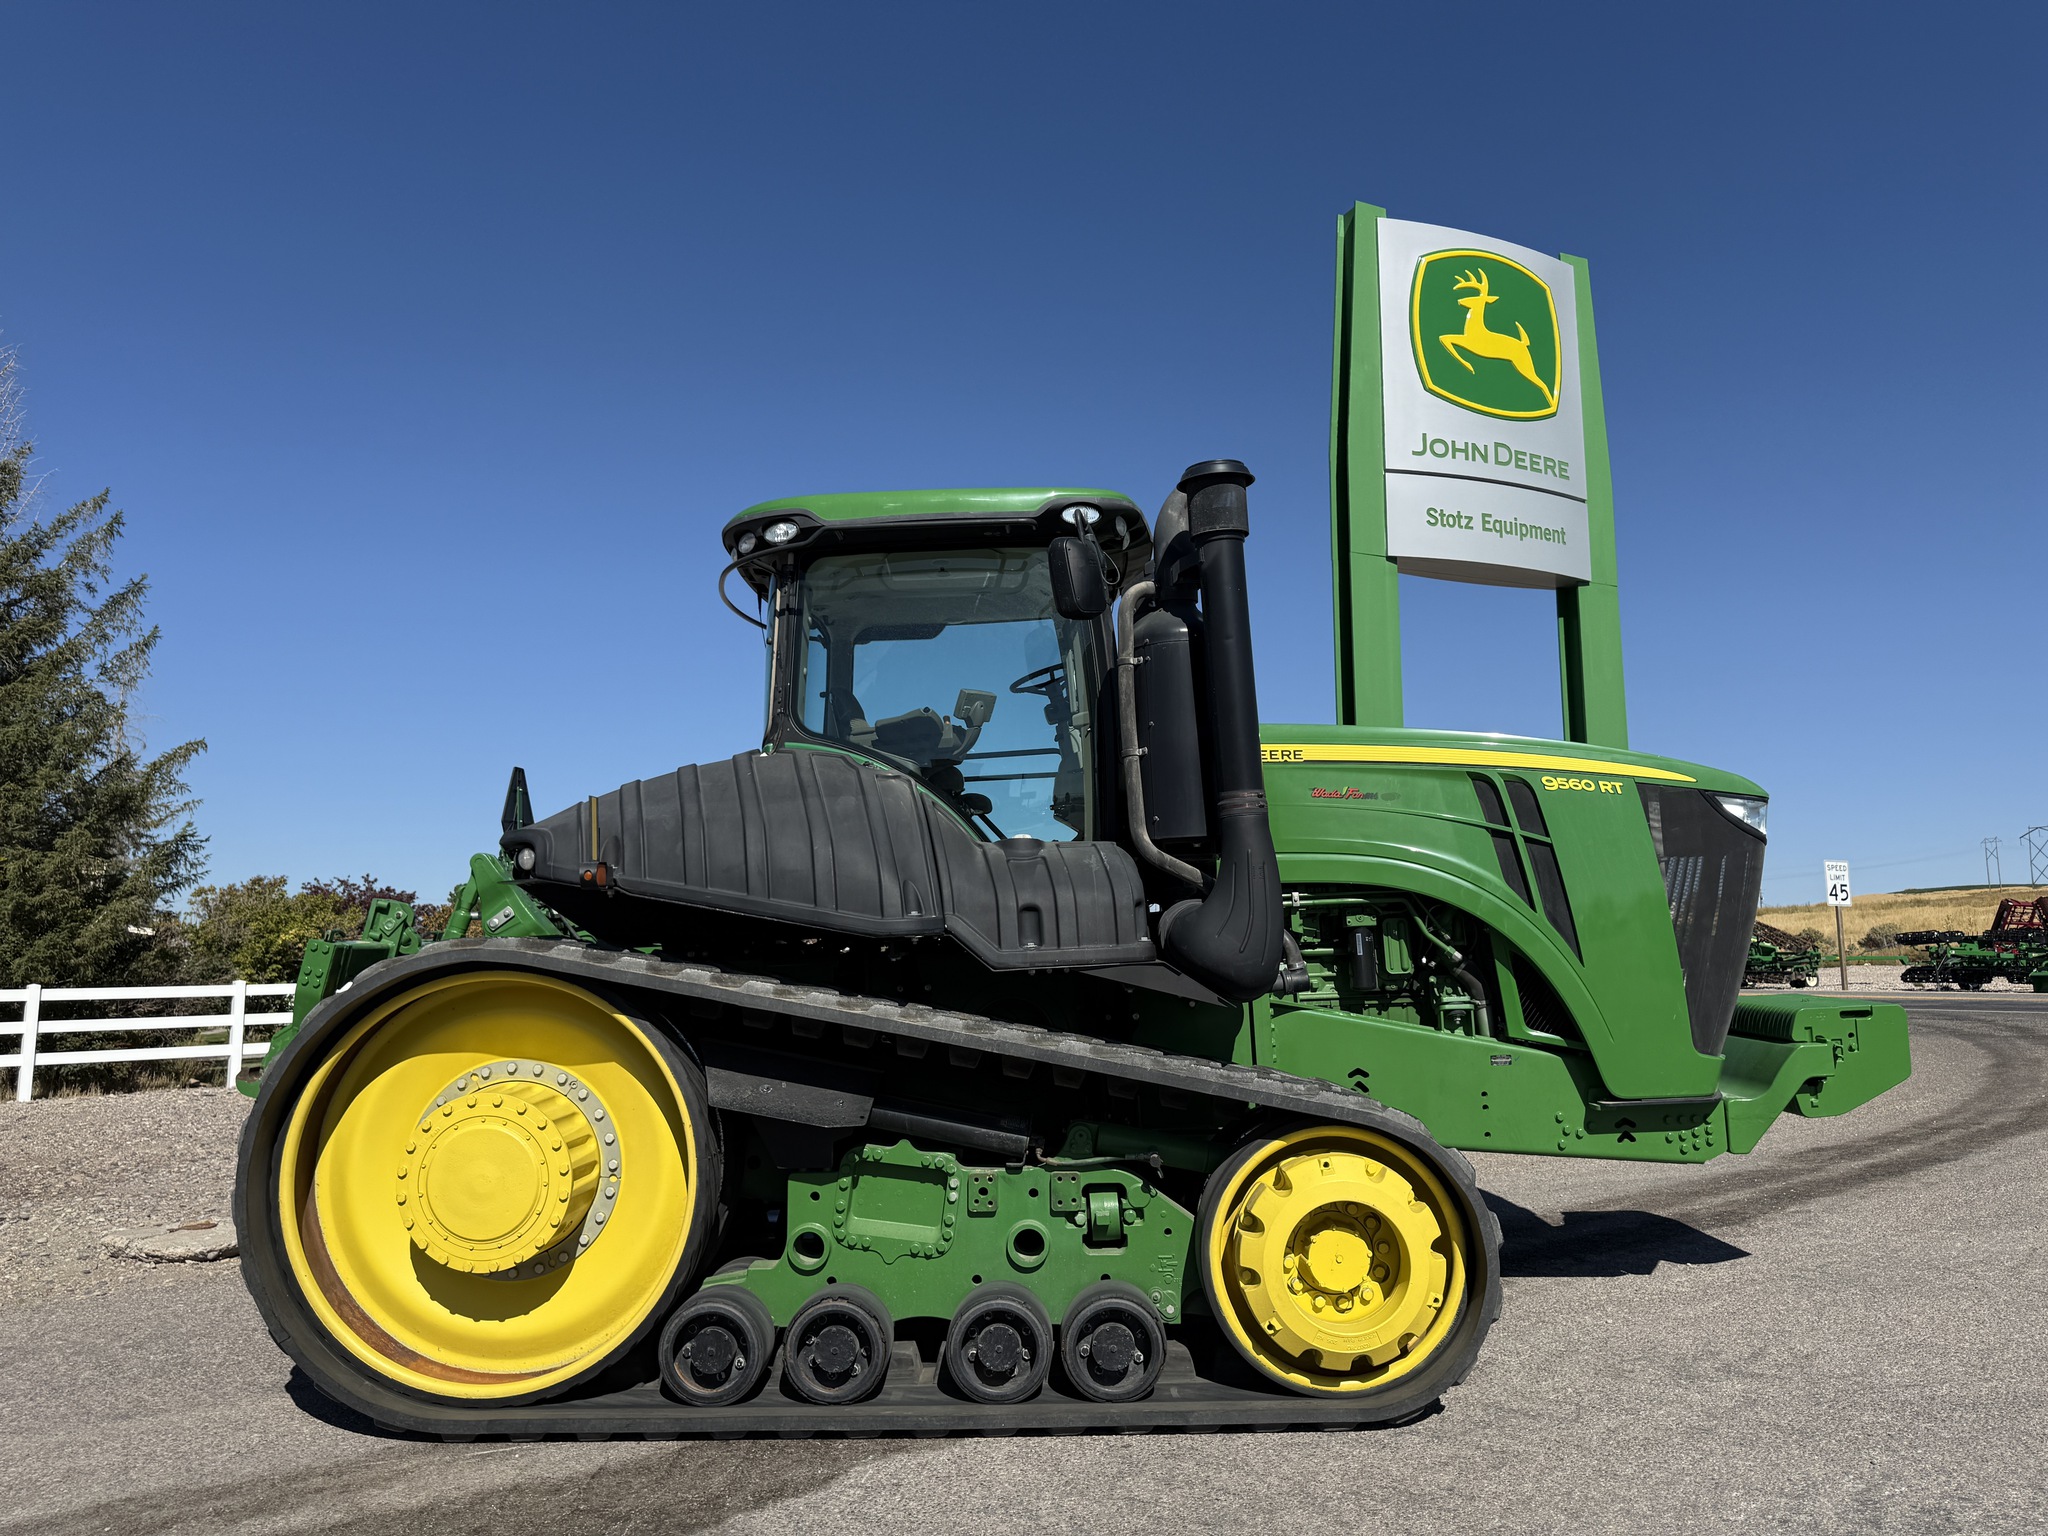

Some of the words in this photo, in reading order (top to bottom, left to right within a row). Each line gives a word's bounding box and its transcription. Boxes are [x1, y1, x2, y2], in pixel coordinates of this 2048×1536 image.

[1411, 432, 1489, 464] JOHN
[1493, 441, 1570, 481] DEERE
[1425, 506, 1474, 531] Stotz
[1481, 512, 1567, 546] Equipment
[1261, 749, 1304, 760] EERE
[1541, 775, 1596, 792] 9560
[1598, 780, 1624, 795] RT
[1826, 864, 1848, 872] SPEED
[1829, 883, 1849, 901] 45
